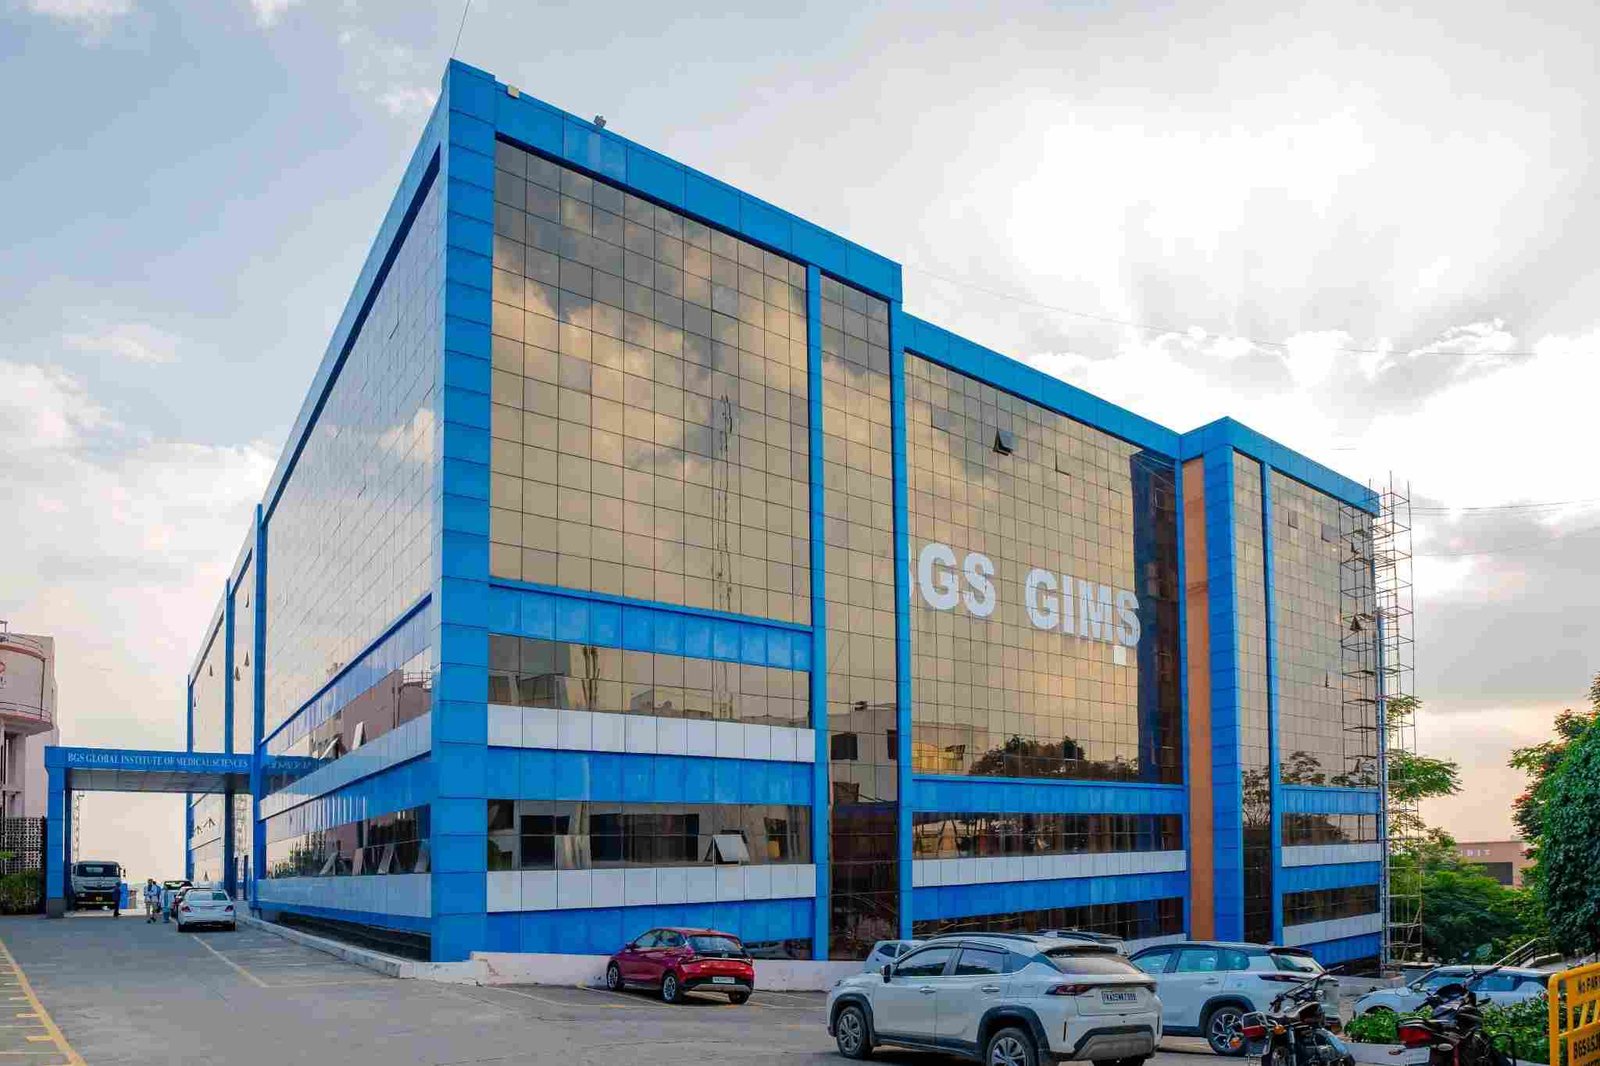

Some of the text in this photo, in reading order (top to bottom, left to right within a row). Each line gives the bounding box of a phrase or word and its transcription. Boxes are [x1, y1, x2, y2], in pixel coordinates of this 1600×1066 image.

[909, 542, 1142, 647] GS GIMS
[67, 752, 249, 769] BGS GLOBAL INSTITUTE OF MEDICAL SCIENCES
